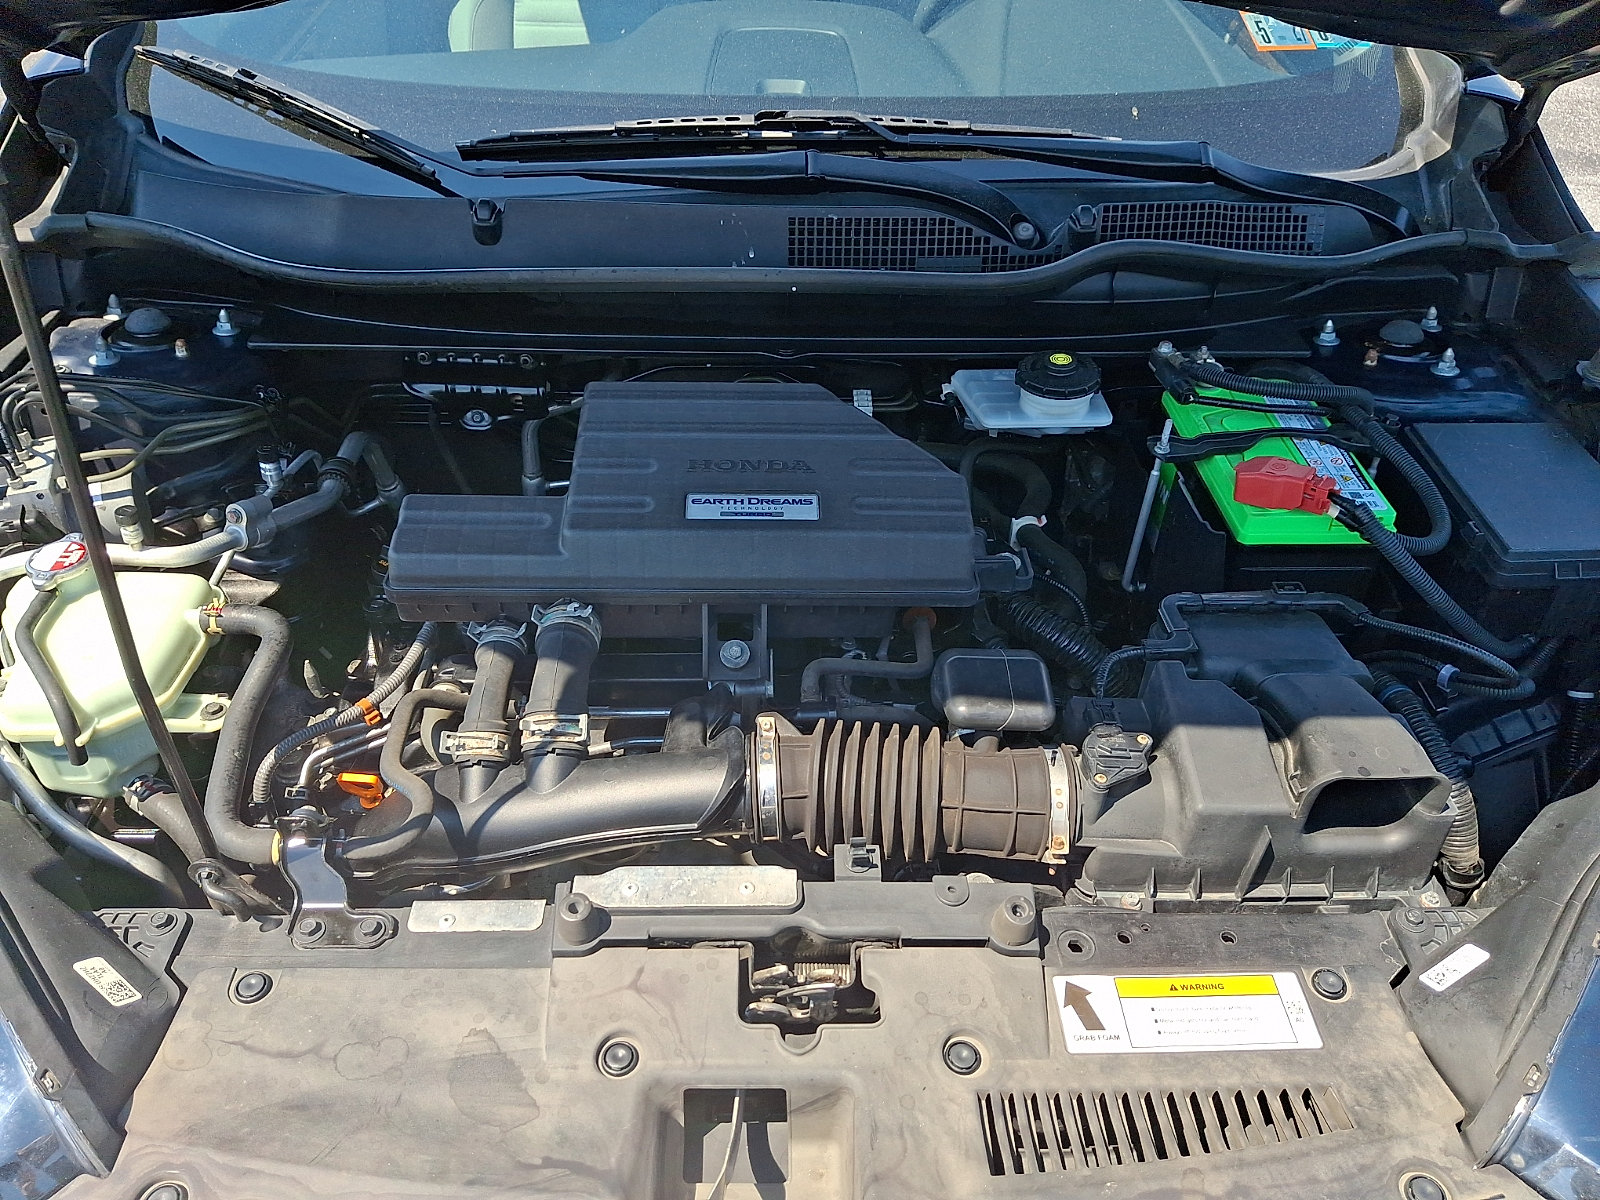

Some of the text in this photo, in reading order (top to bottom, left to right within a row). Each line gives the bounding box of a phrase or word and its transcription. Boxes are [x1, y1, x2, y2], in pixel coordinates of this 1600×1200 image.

[685, 458, 817, 474] HONDA
[690, 497, 814, 506] EARTH DREAMS
[1179, 983, 1225, 991] WARNING
[1073, 1034, 1121, 1042] GRAB FOAM
